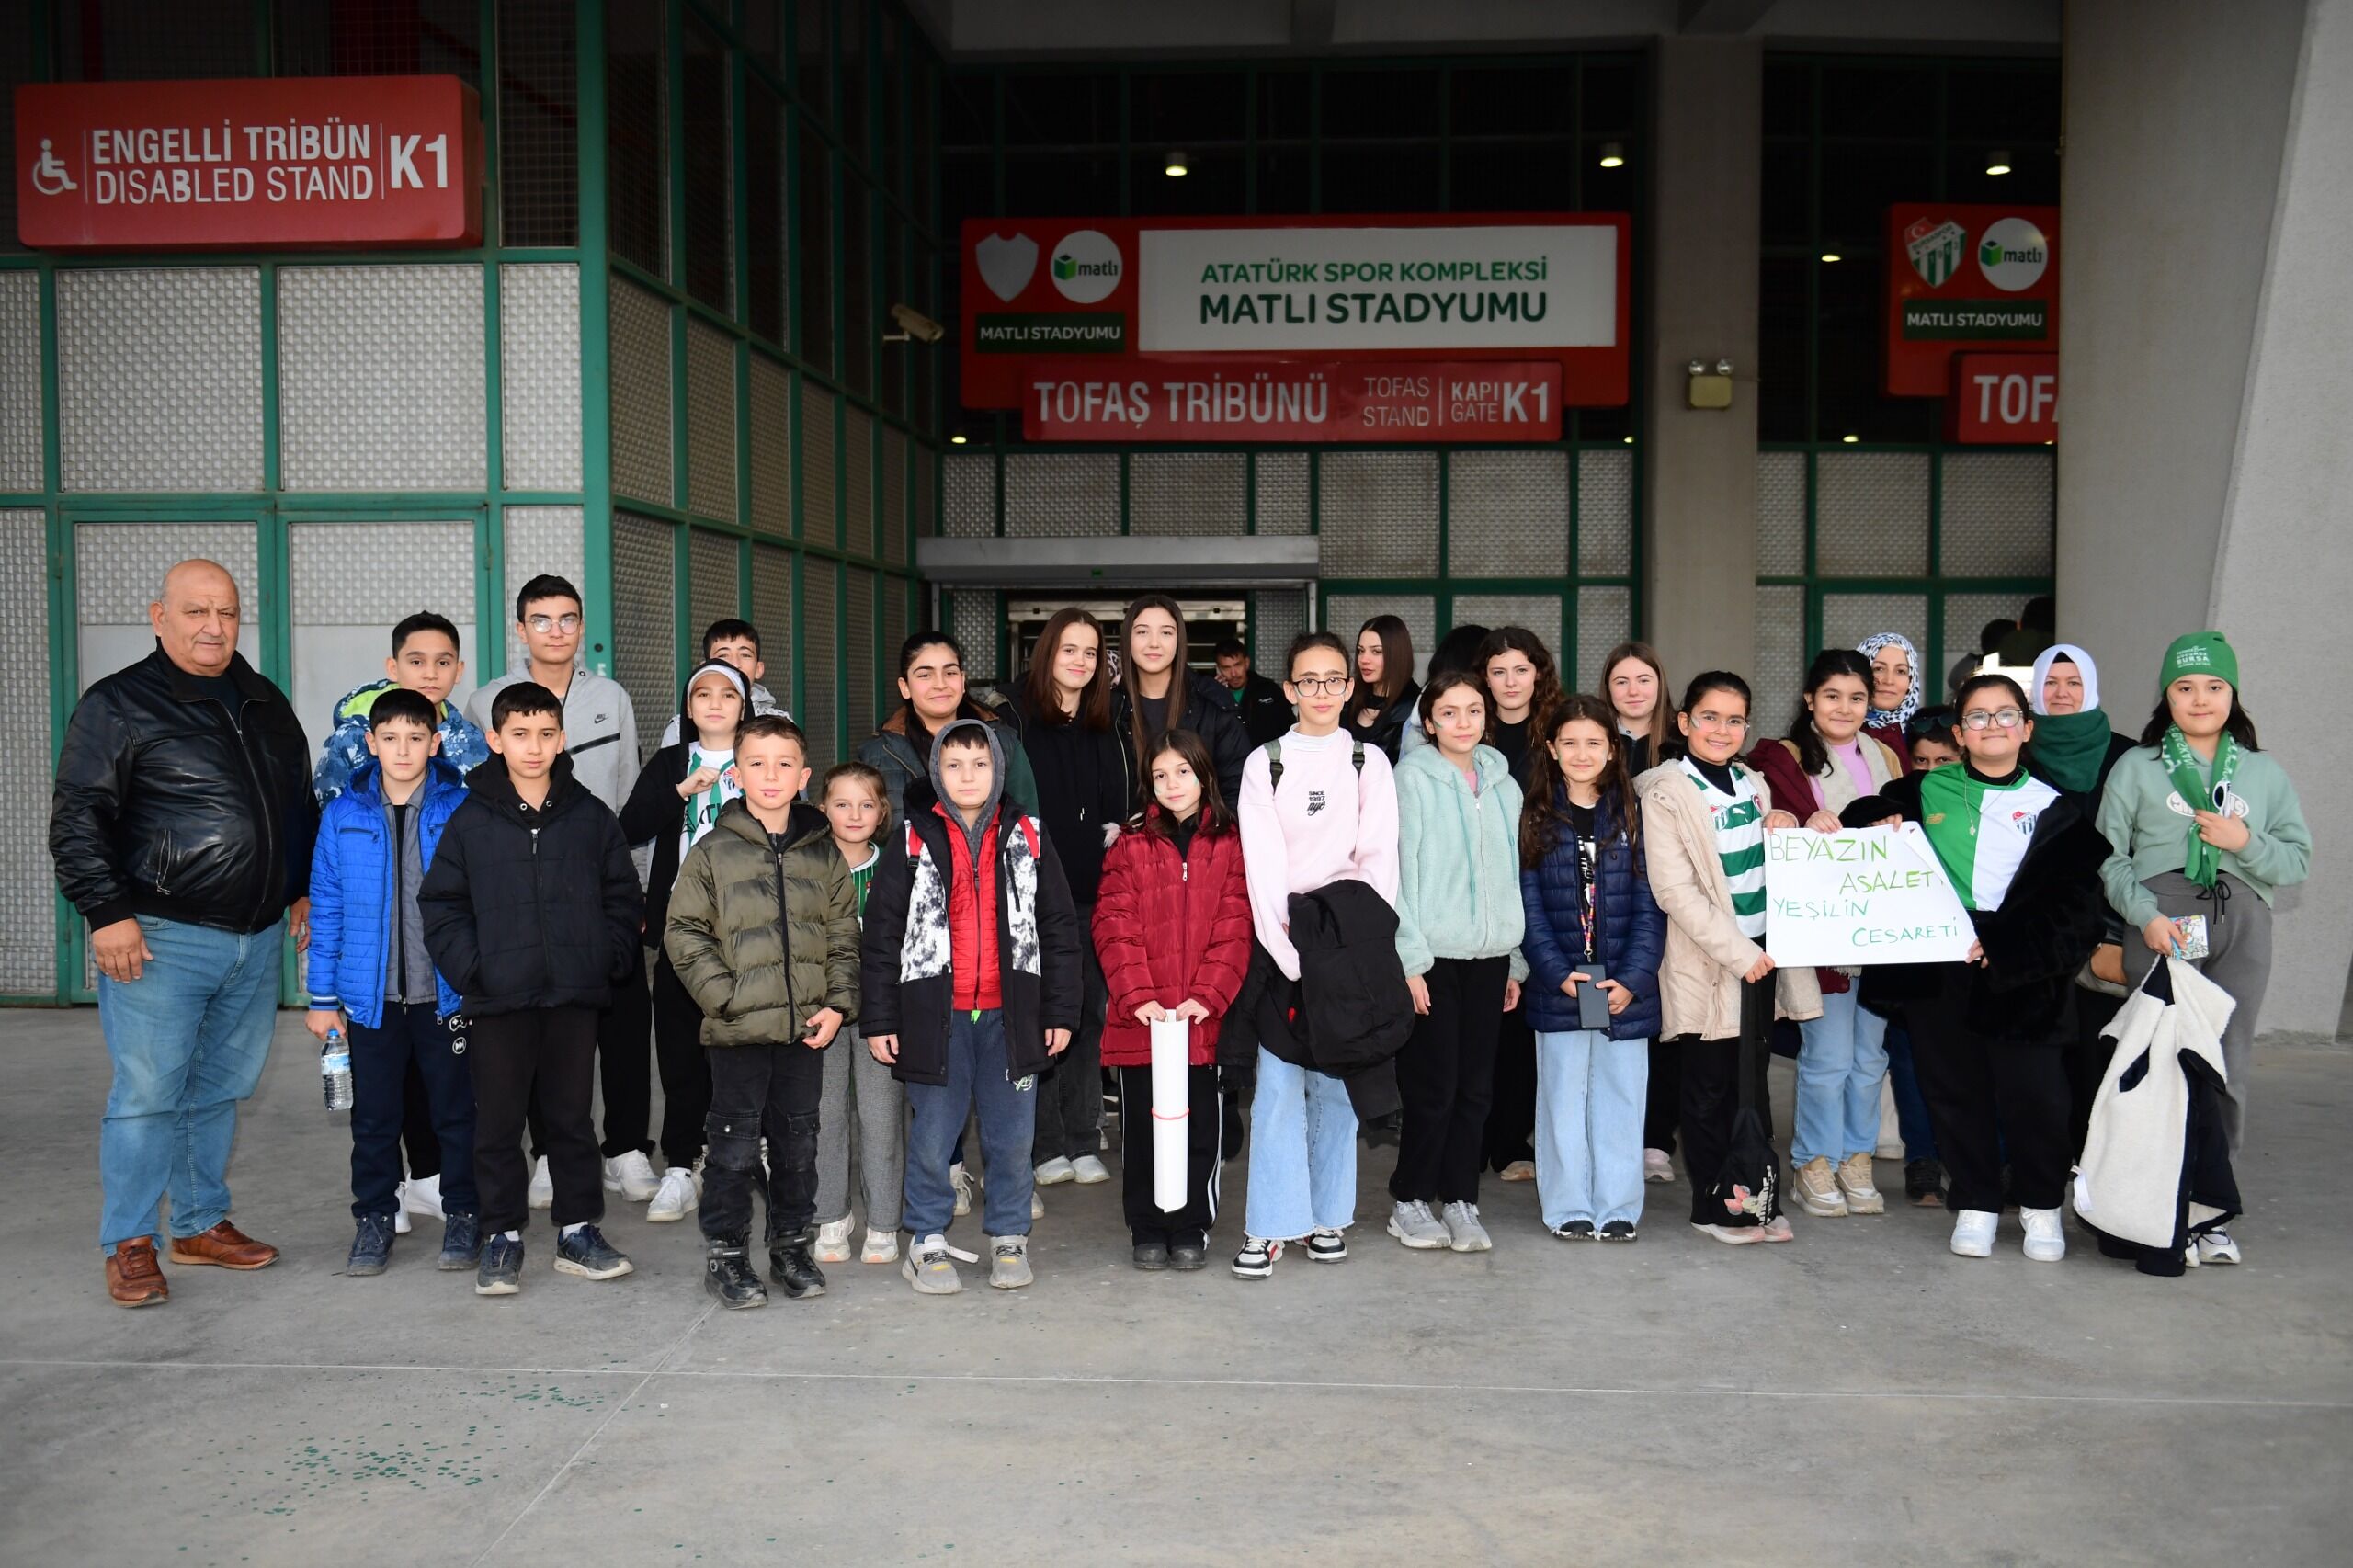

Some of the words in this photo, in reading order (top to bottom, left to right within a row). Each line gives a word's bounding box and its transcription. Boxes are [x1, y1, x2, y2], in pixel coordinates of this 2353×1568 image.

[93, 119, 231, 164] ENGELLİ
[244, 117, 370, 161] TRİBÜN
[390, 134, 448, 188] K1
[97, 168, 254, 204] DISABLED
[267, 165, 373, 201] STAND
[1078, 260, 1118, 277] matlı
[2004, 246, 2042, 264] matlı
[1200, 257, 1318, 283] ATATÜRK
[1324, 262, 1393, 282] SPOR
[1400, 256, 1547, 282] KOMPLEKSİ
[1200, 293, 1315, 324] MATLI
[1325, 291, 1546, 324] STADYUMU
[1906, 312, 1953, 326] MATLI
[1957, 312, 2042, 326] STADYUMU
[981, 326, 1028, 339] MATLI
[1031, 326, 1120, 339] STADYUMU
[1033, 381, 1150, 429] TOFAŞ
[1163, 372, 1327, 424] TRİBÜNÜ
[1451, 382, 1498, 402] KAPI
[1503, 381, 1548, 423] K1
[1973, 374, 2058, 424] TOF
[1363, 406, 1430, 426] STAND
[1451, 403, 1498, 423] GATE
[1769, 834, 1887, 862] BEYAZIN
[1773, 897, 1869, 920] YEŞİLİN
[1852, 916, 1958, 947] CESARETİ
